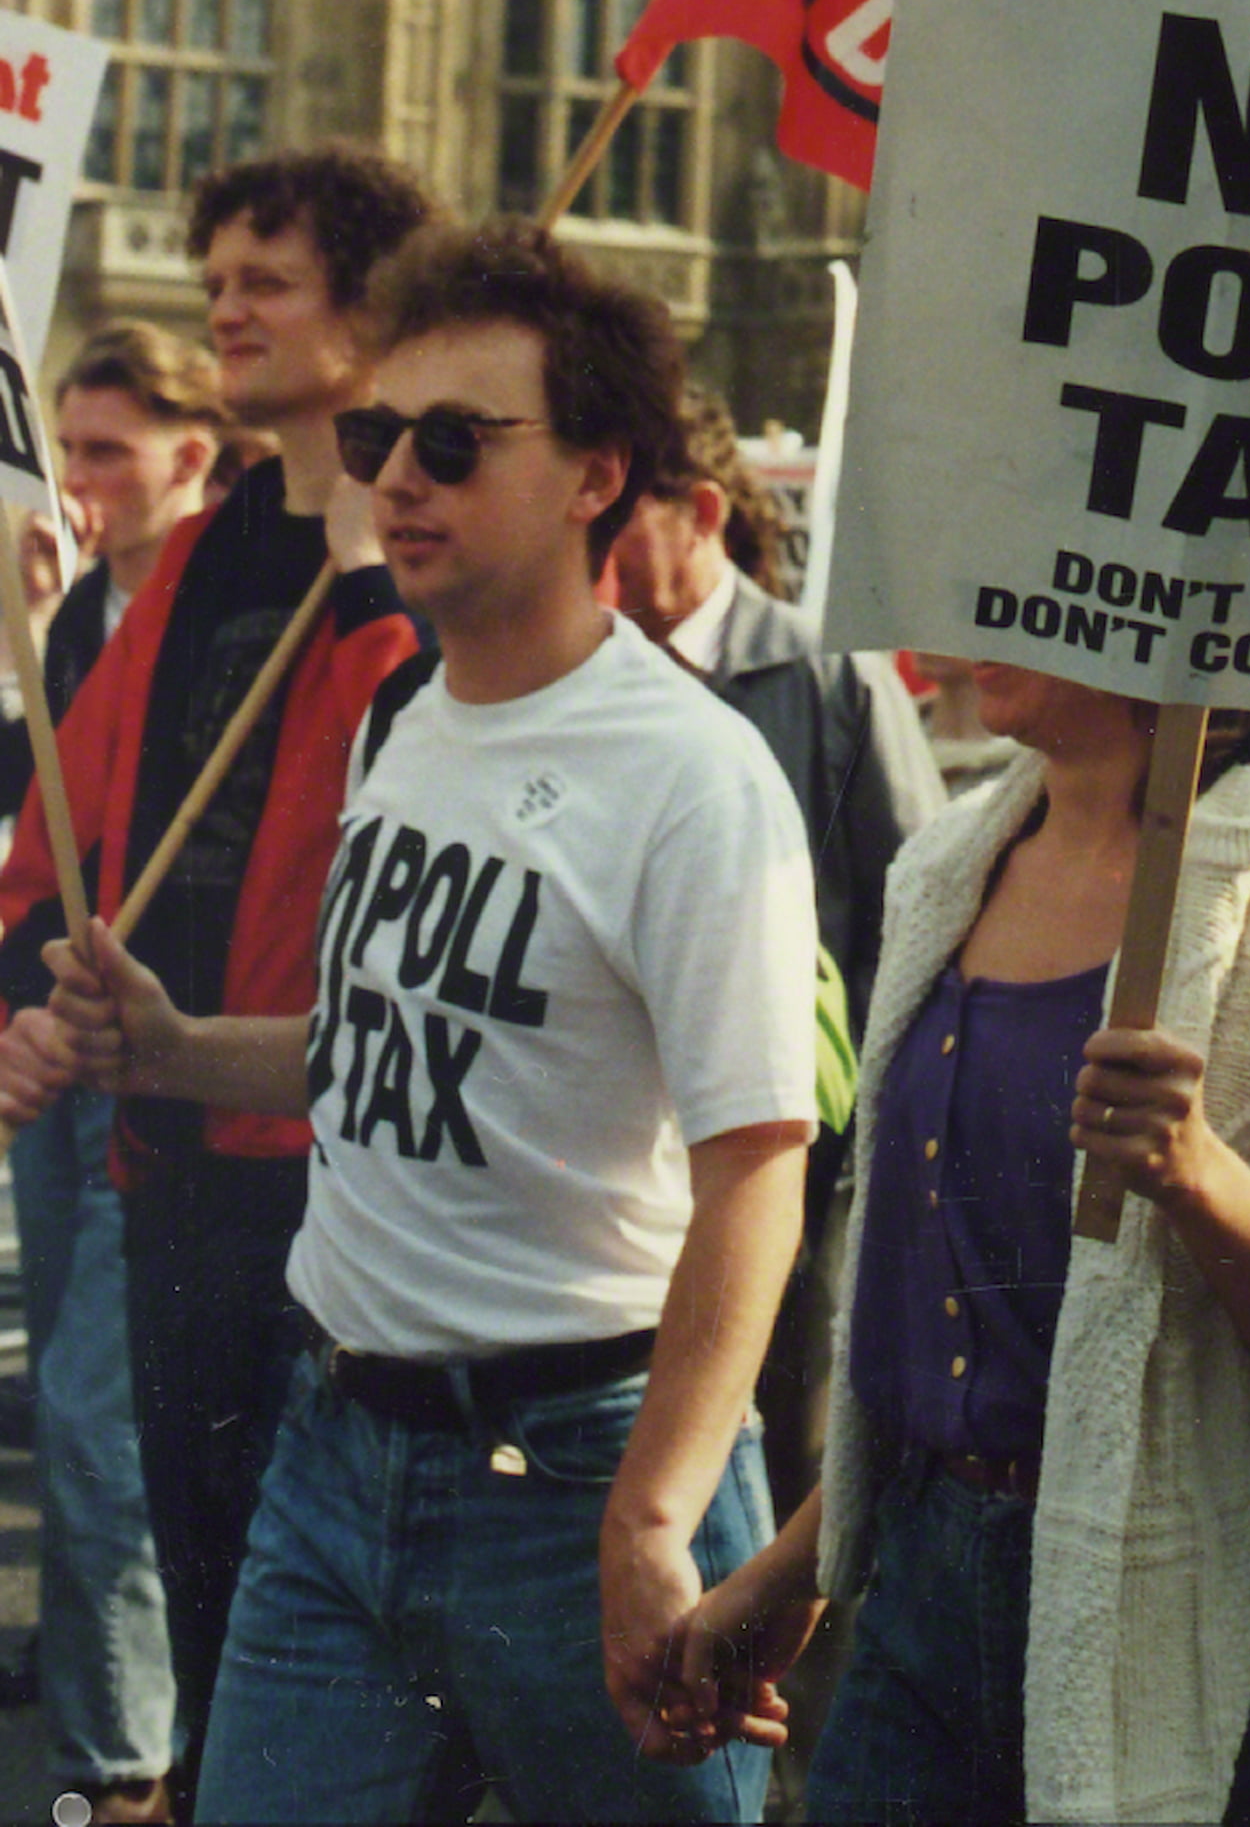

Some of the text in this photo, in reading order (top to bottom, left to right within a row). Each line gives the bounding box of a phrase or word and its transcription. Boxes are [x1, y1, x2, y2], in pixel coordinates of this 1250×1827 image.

[974, 586, 1167, 664] DON'T
[1053, 549, 1245, 624] DON'T
[351, 824, 548, 1028] POLL
[340, 985, 488, 1167] TAX
